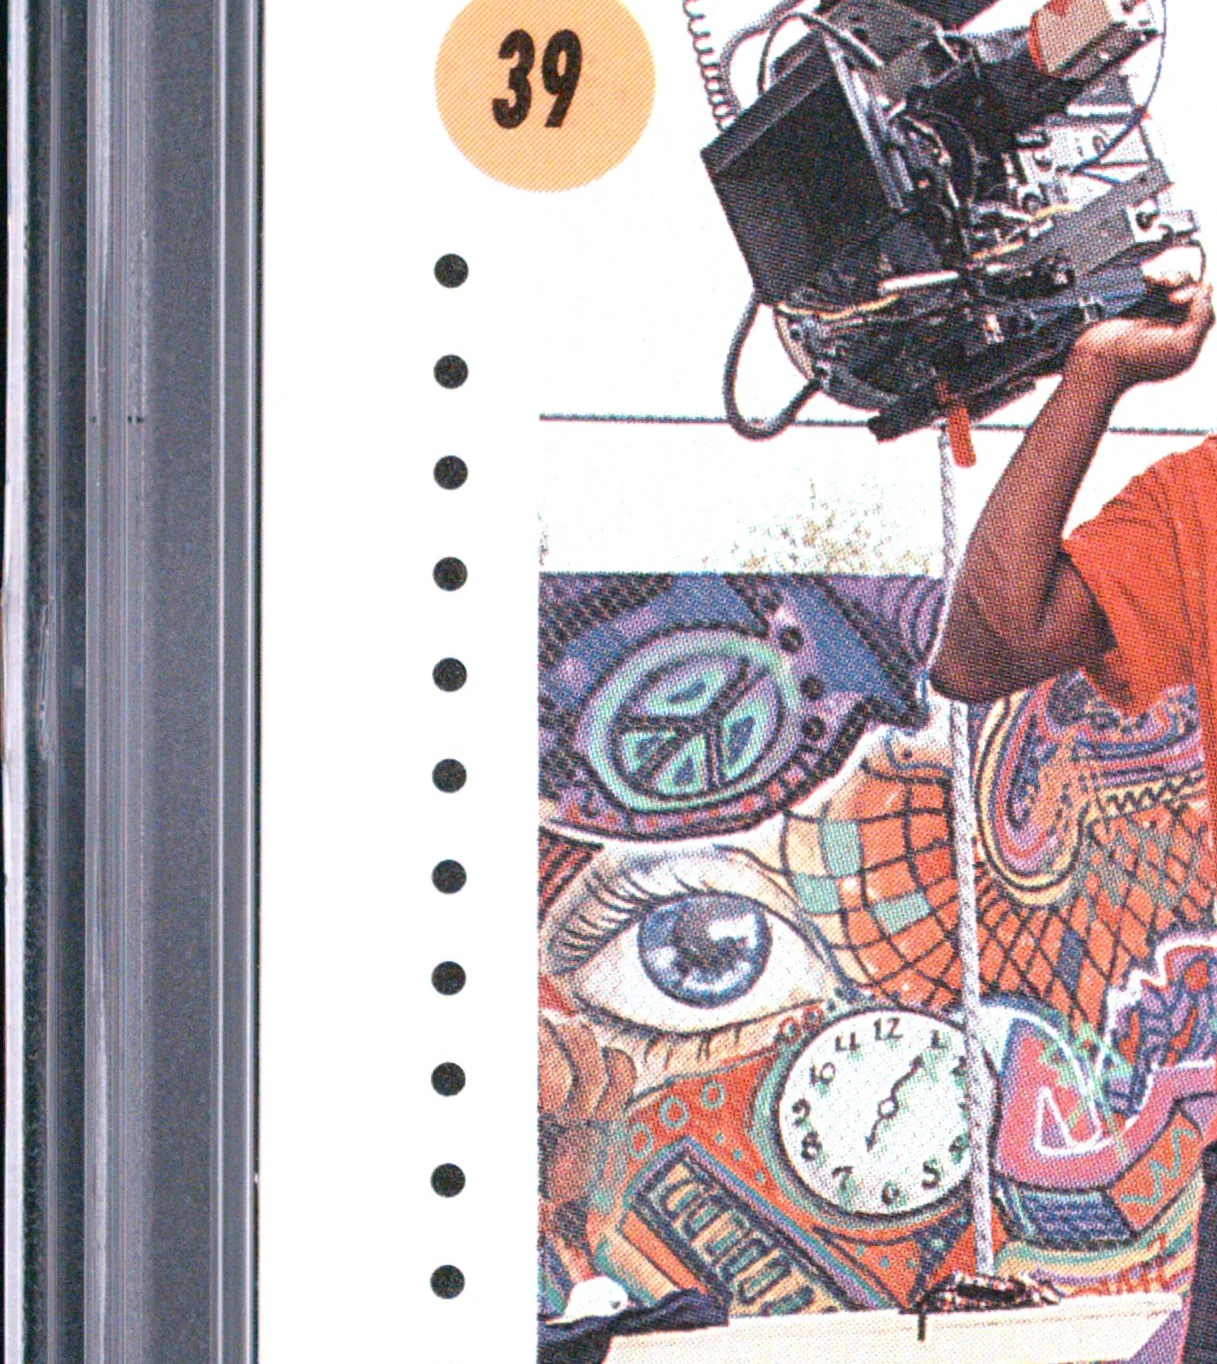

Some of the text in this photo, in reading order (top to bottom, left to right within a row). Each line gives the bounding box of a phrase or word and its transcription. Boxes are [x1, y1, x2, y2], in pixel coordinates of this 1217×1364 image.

[492, 29, 583, 129] 39
[874, 1017, 904, 1041] 12
[809, 1061, 836, 1087] 10
[791, 1097, 811, 1126] 9
[800, 1130, 823, 1161] 8
[832, 1165, 854, 1192] 7
[922, 1158, 943, 1189] 5
